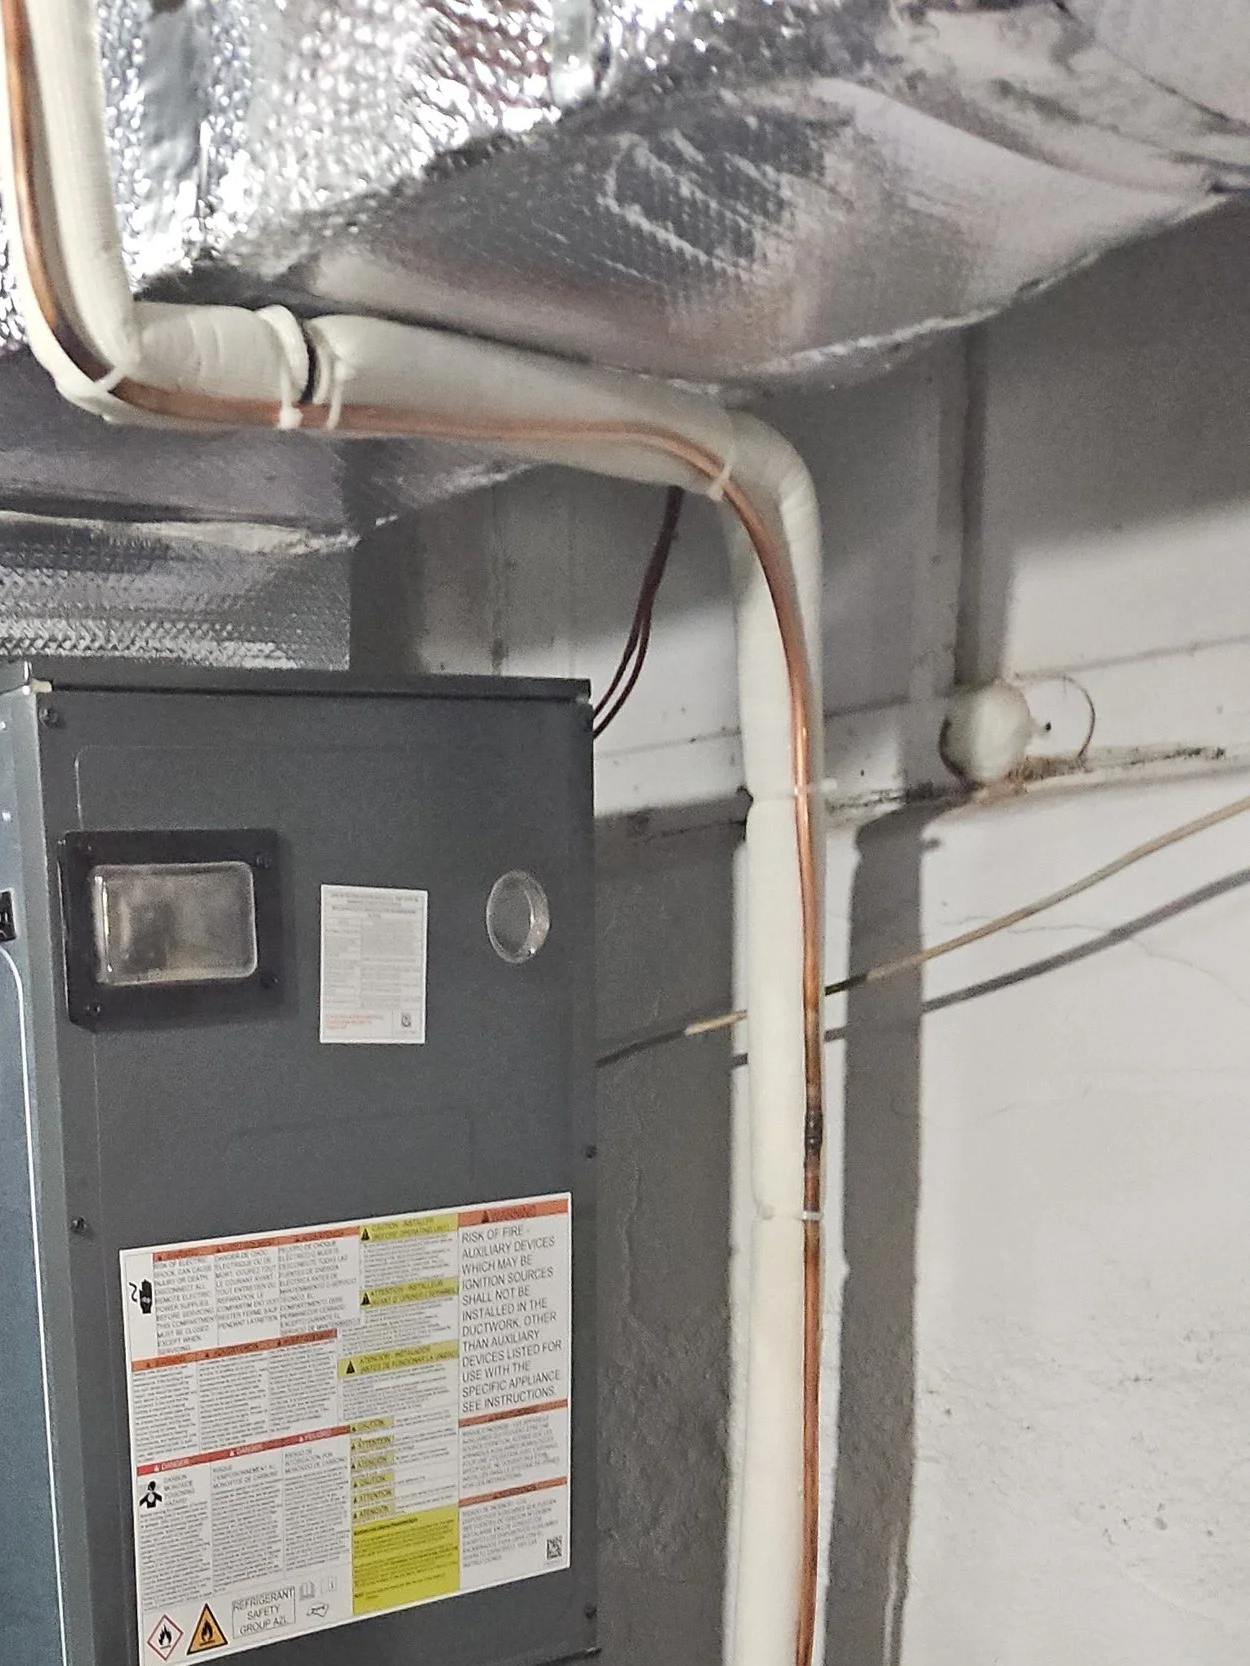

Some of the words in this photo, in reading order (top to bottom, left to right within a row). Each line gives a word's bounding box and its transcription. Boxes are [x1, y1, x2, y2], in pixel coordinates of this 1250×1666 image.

[462, 1229, 484, 1244] RISK
[486, 1227, 498, 1240] OF
[502, 1224, 522, 1238] FIRE
[461, 1241, 512, 1259] AUXILIARY
[514, 1235, 554, 1252] DEVICES
[461, 1259, 494, 1275] WHICH
[497, 1256, 517, 1270] MAY
[520, 1253, 533, 1266] BE
[462, 1273, 504, 1290] IGNITION
[507, 1266, 553, 1283] SOURCES
[462, 1291, 492, 1306] SHALL
[495, 1287, 515, 1300] NOT
[518, 1284, 530, 1297] BE
[462, 1302, 514, 1322] INSTALLED
[517, 1300, 525, 1313] IN
[529, 1297, 546, 1311] THE
[524, 1310, 556, 1327] OTHER
[462, 1337, 488, 1352] THAN
[491, 1328, 539, 1347] AUXILIARY
[462, 1349, 504, 1367] DEVICES
[507, 1343, 540, 1359] LISTED
[542, 1339, 561, 1353] FOR
[462, 1369, 482, 1383] USE
[484, 1363, 509, 1379] WITH
[512, 1360, 530, 1373] THE
[462, 1379, 506, 1398] SPECIFIC
[462, 1399, 481, 1413] SEE
[232, 1586, 293, 1611] REFRIGERANT
[246, 1604, 278, 1620] SAFETY
[239, 1618, 271, 1636] GROUP
